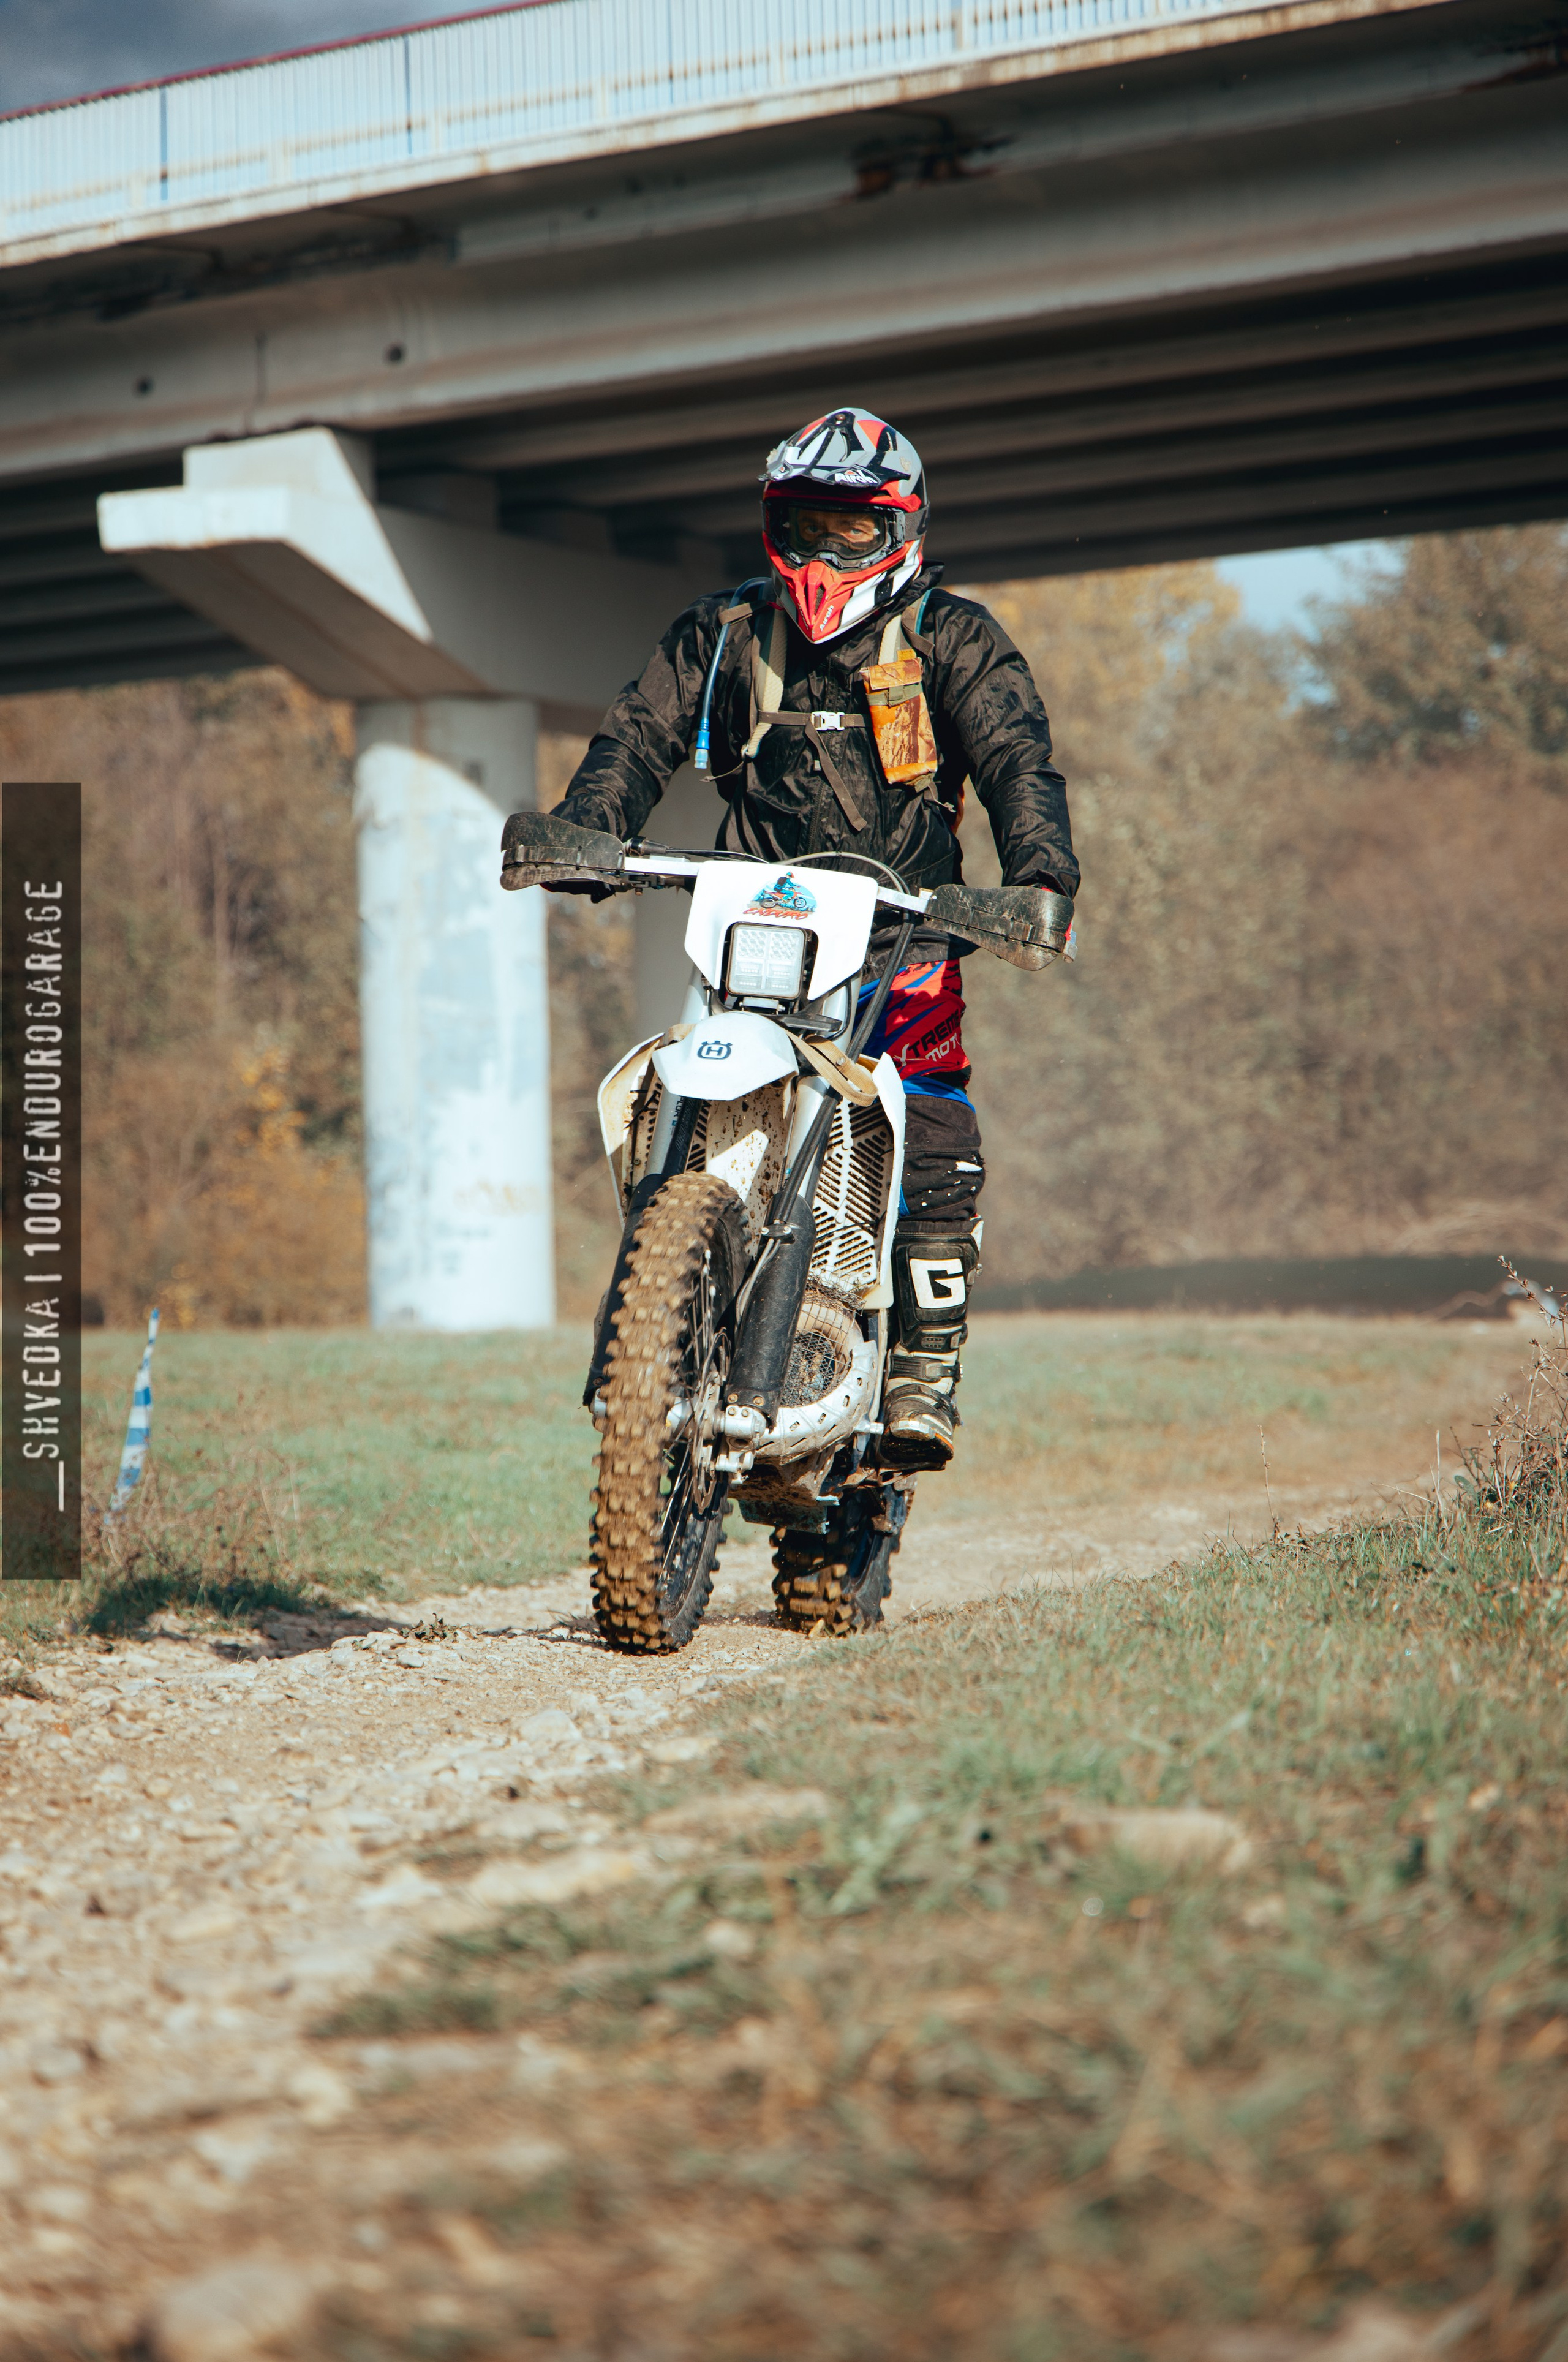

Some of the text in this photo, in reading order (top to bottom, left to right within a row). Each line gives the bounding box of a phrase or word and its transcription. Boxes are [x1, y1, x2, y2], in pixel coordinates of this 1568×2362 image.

[834, 470, 878, 484] Airoh
[819, 605, 834, 632] Airoh
[742, 907, 809, 920] ENDURO
[925, 1032, 960, 1062] MOT
[910, 1258, 966, 1308] G
